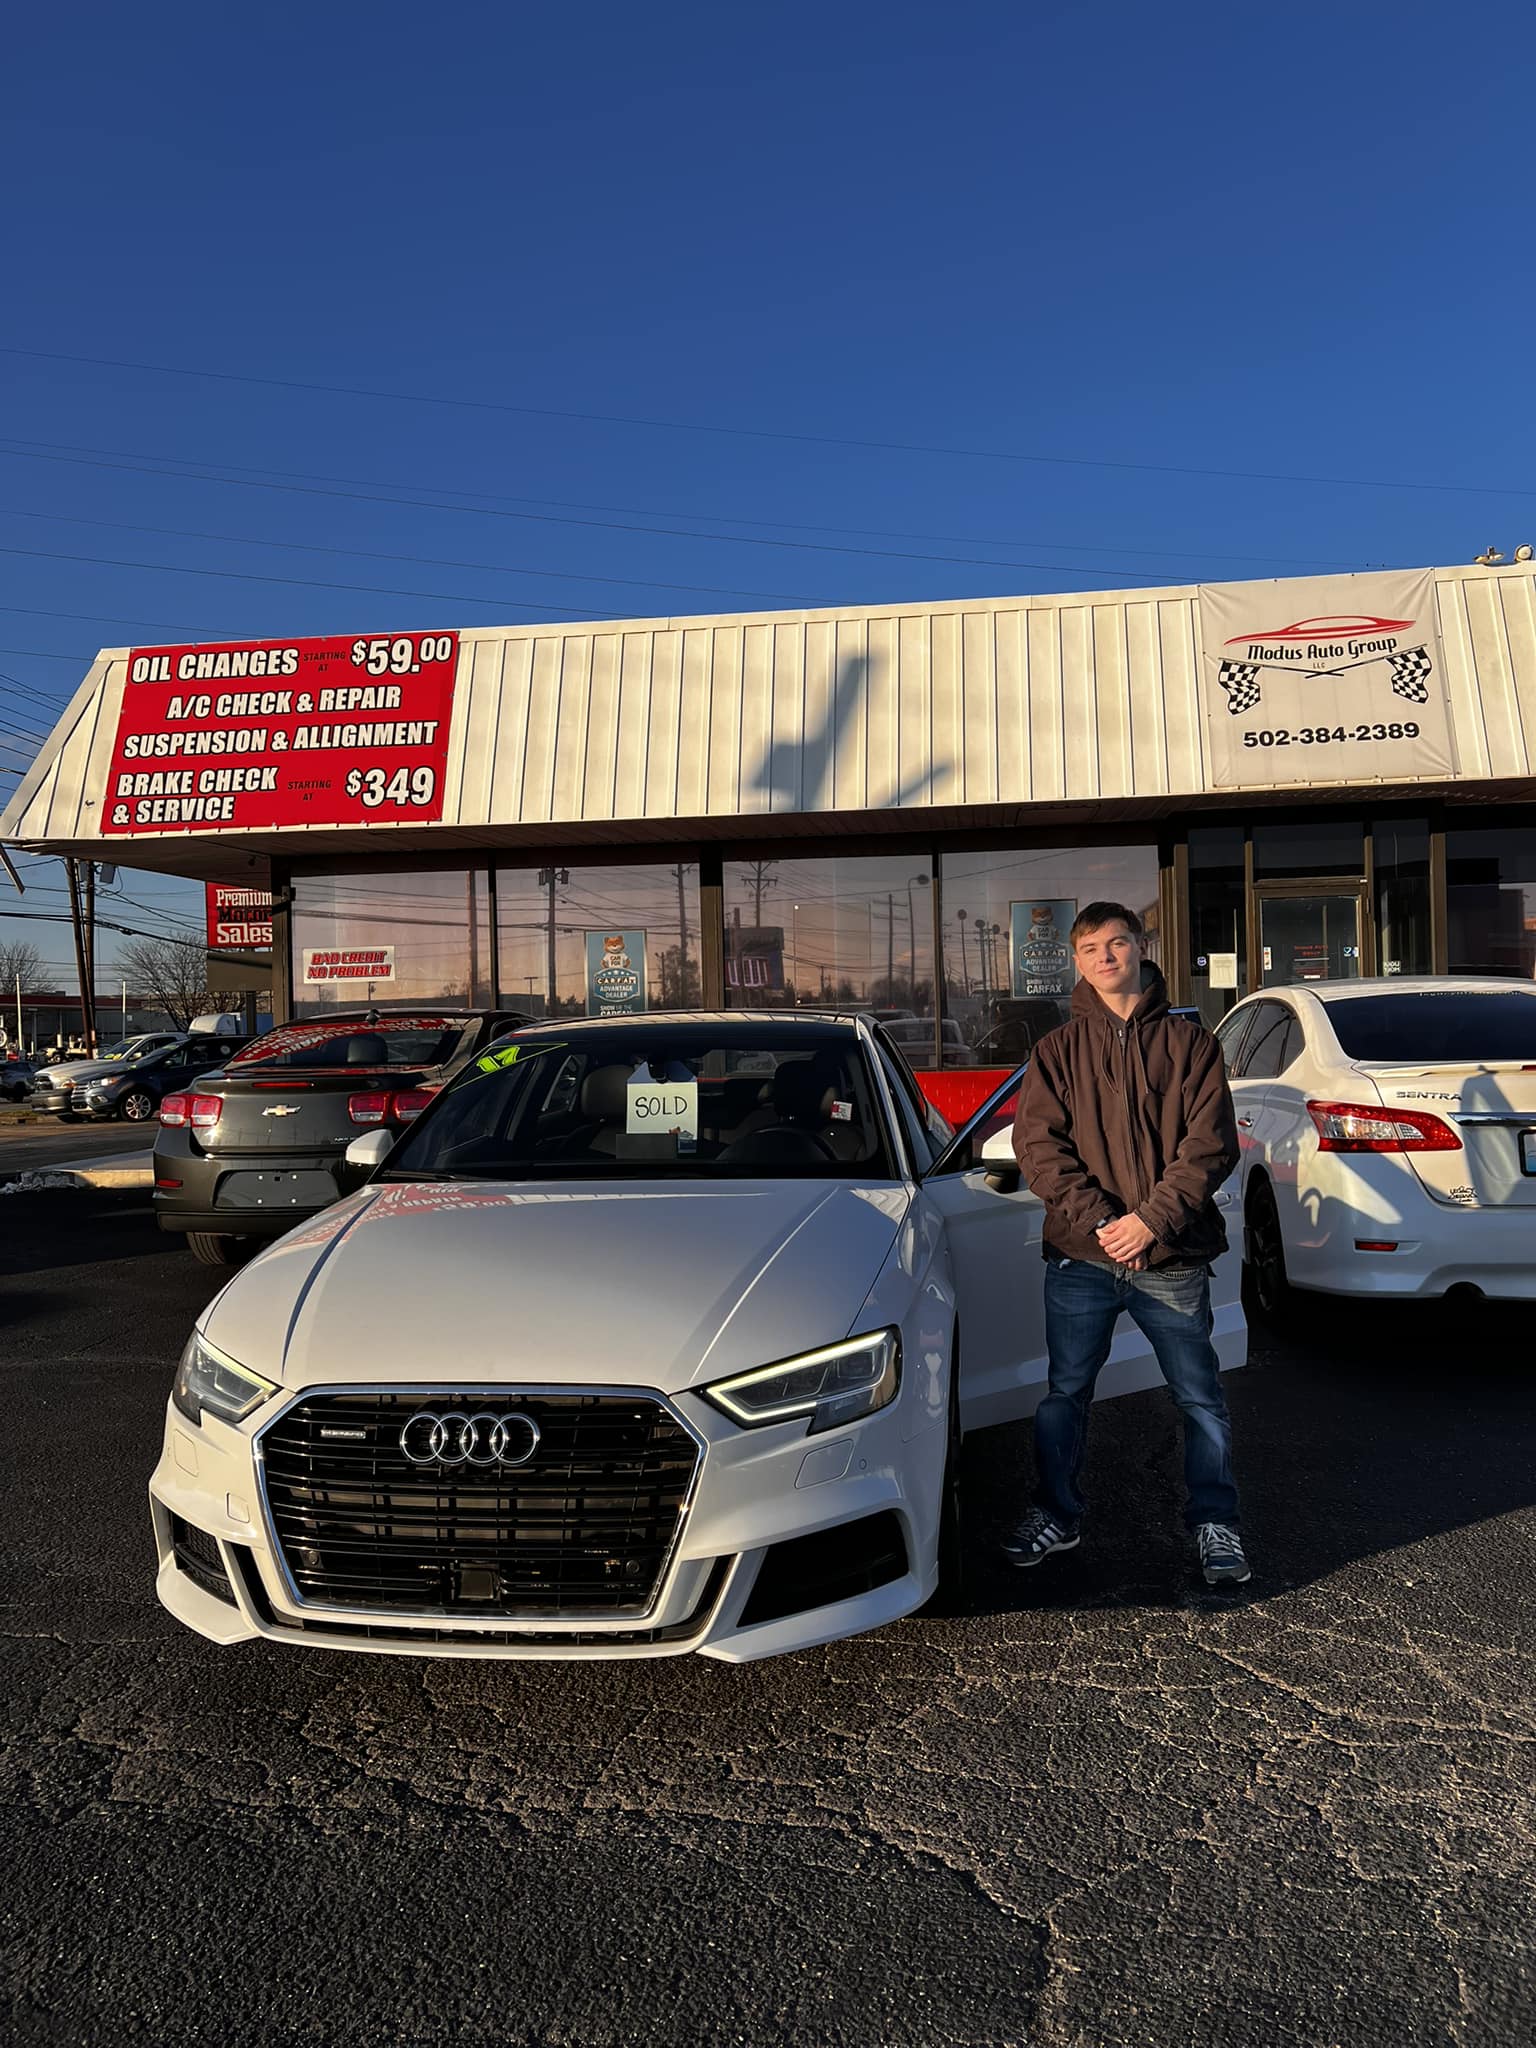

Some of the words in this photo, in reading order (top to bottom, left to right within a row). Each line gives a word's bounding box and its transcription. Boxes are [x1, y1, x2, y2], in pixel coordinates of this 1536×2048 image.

[303, 651, 346, 661] STARTING
[352, 636, 452, 675] $59.00
[1248, 644, 1303, 660] Modus
[1308, 644, 1344, 659] Auto
[1347, 638, 1397, 659] Group
[132, 655, 171, 683] OIL
[178, 648, 299, 680] CHANGES
[318, 664, 328, 672] AT
[166, 695, 211, 720] A/C
[216, 691, 293, 716] CHECK
[297, 693, 313, 713] &
[319, 685, 401, 711] REPAIR
[124, 728, 267, 758] SUSPENSION
[271, 730, 288, 751] &
[293, 721, 438, 750] ALLIGNMENT
[1243, 722, 1419, 747] 502-384-2389
[117, 771, 193, 797] BRAKE
[199, 767, 278, 793] CHECK
[288, 779, 331, 790] STARTING
[346, 766, 435, 806] $349
[303, 793, 313, 801] AT
[112, 804, 130, 824] &
[136, 796, 235, 823] SERVICE
[216, 888, 272, 906] Premium
[217, 922, 272, 944] Sales
[311, 951, 340, 965] BAD
[341, 951, 387, 964] CREDIT
[307, 966, 328, 979] NO
[328, 964, 392, 979] PROBLEM
[1026, 984, 1062, 994] CARFAX
[635, 1096, 688, 1118] SOLD
[1396, 1091, 1463, 1101] SENTRA
